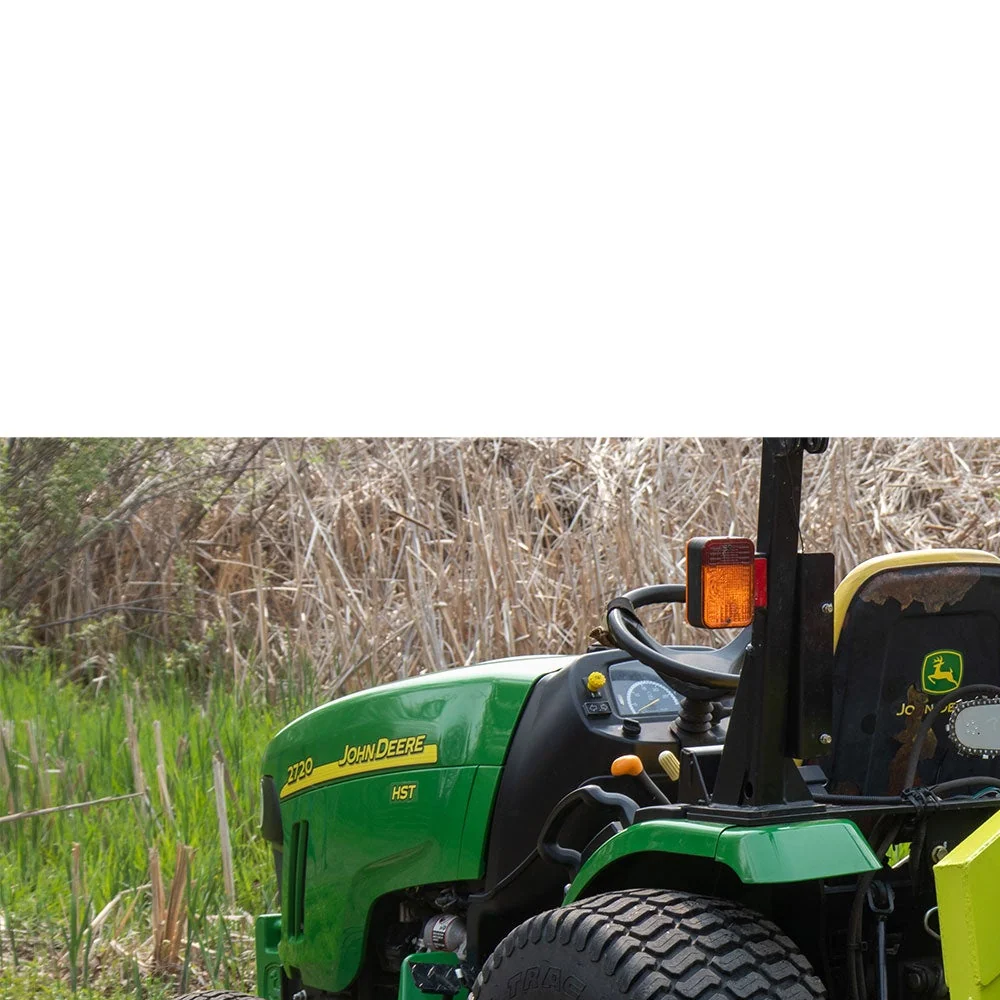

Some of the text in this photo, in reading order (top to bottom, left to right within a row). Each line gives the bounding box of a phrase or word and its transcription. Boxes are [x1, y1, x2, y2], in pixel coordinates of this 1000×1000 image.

[896, 703, 934, 716] JON
[338, 734, 427, 766] JOHN DEERE
[287, 757, 314, 785] 2720
[391, 784, 416, 800] HST
[507, 966, 586, 1000] TRAC
